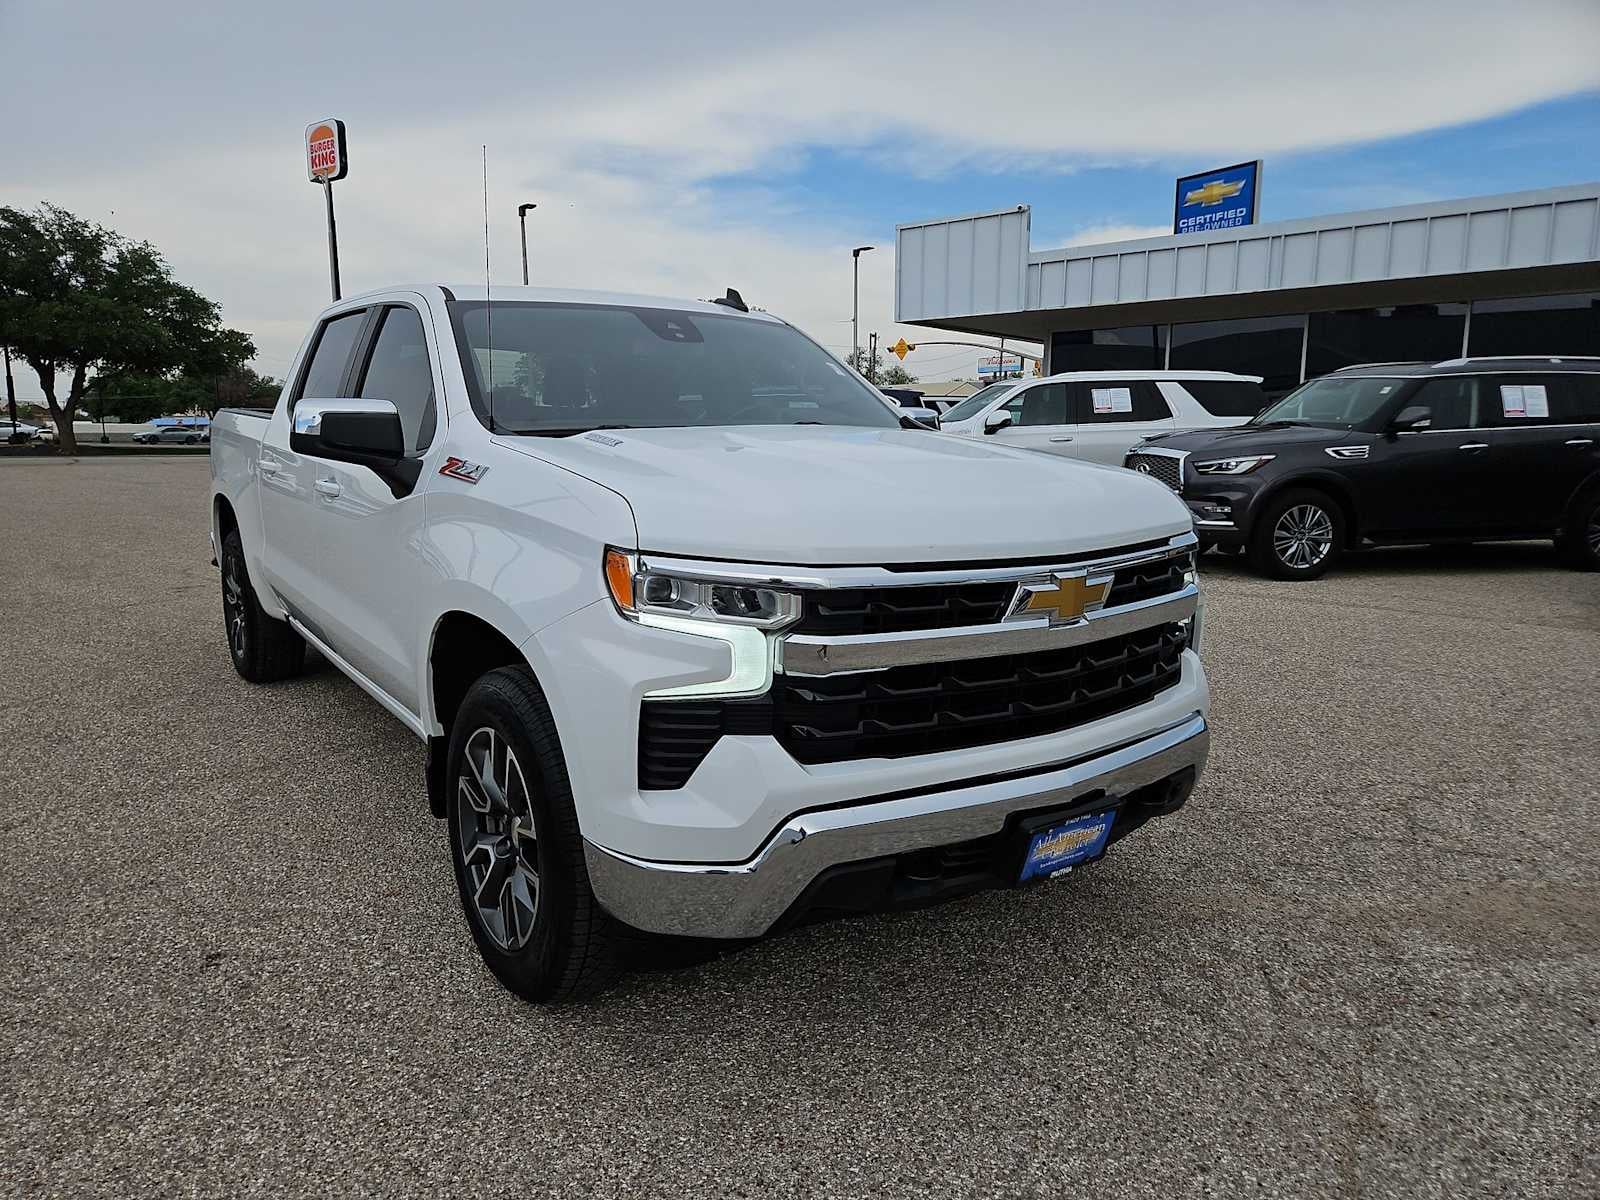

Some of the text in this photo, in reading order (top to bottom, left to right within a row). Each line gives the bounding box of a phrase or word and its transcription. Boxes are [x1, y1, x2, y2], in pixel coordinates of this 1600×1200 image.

[310, 139, 335, 154] BURGER
[311, 150, 336, 169] KING
[1179, 207, 1247, 228] CERTIFIED
[1181, 217, 1242, 234] PRE-OWNED
[438, 456, 489, 485] Z71
